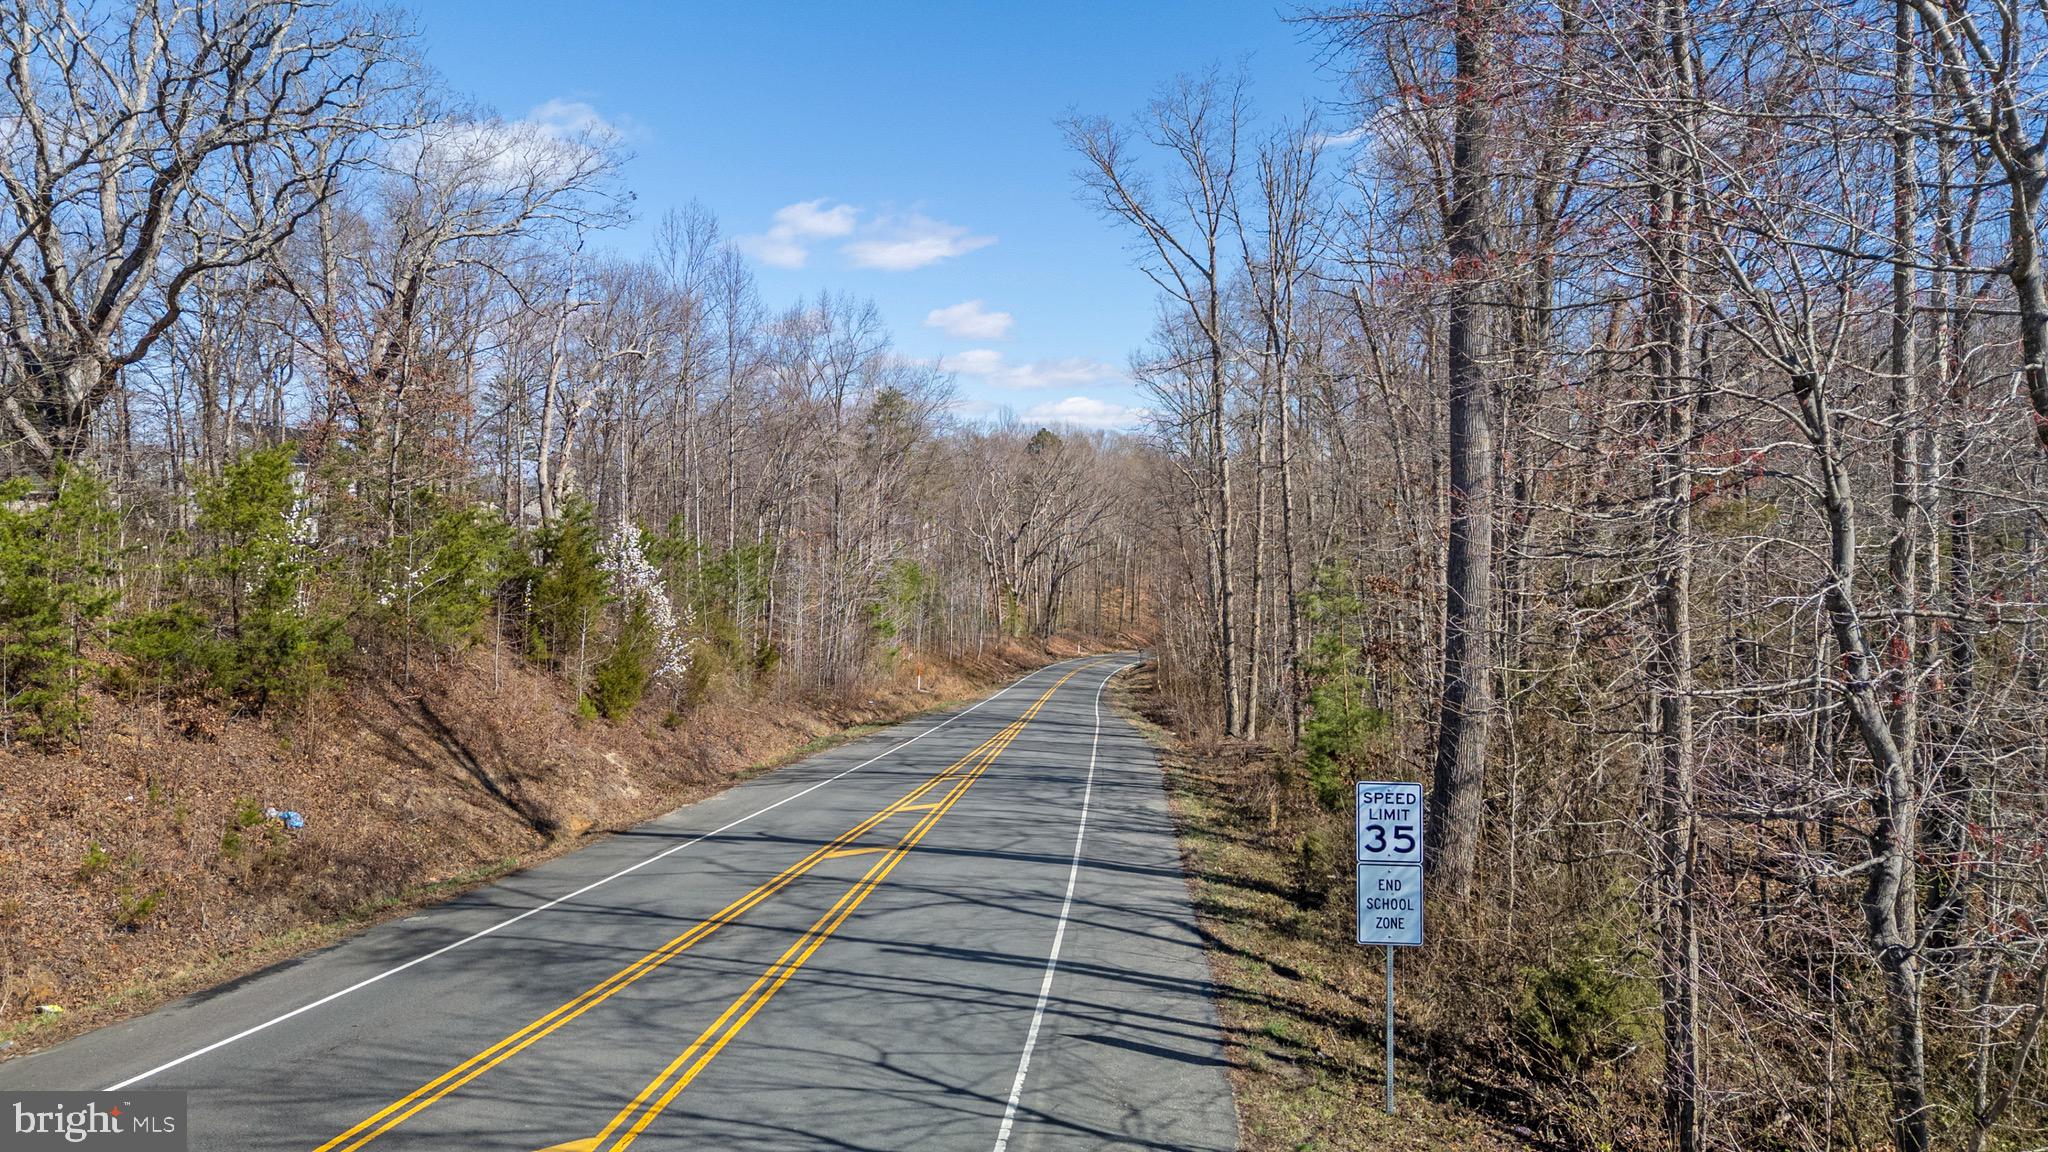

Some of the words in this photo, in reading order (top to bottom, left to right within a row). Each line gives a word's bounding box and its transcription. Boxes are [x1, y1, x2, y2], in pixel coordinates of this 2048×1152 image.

[1363, 792, 1417, 805] SPEED
[1369, 808, 1410, 821] LIMIT
[1364, 824, 1416, 854] 35
[1378, 879, 1402, 892] END
[1366, 897, 1414, 911] SCHOOL
[1375, 917, 1405, 930] ZONE
